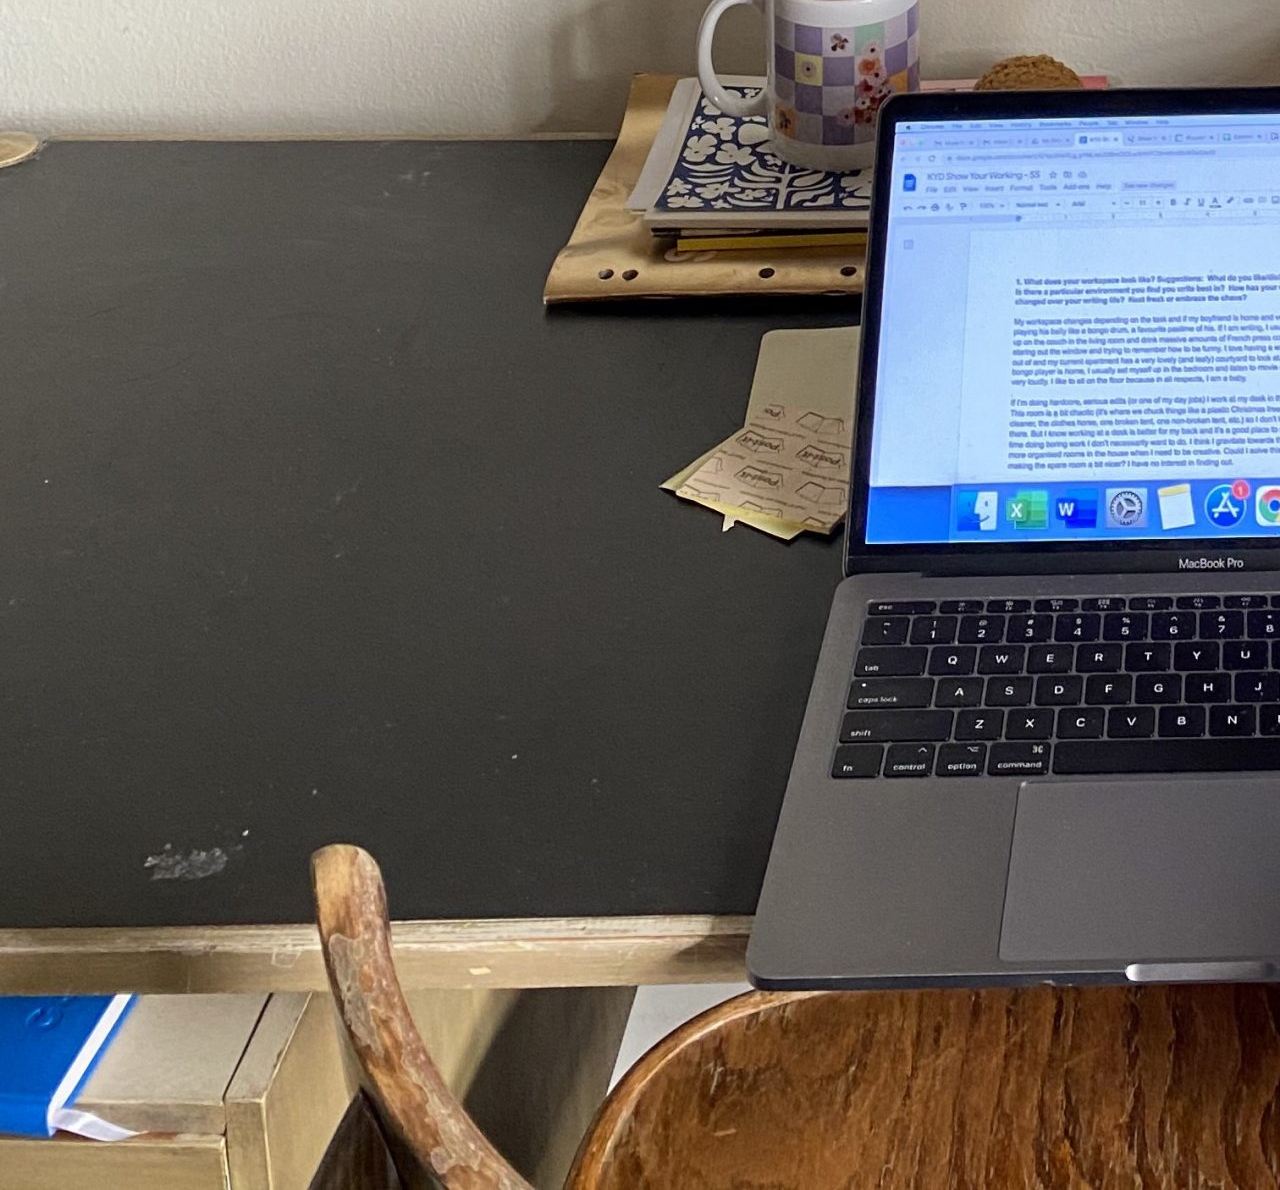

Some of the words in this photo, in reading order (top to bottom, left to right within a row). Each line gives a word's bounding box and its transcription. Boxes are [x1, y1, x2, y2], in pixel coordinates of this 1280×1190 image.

[946, 171, 969, 180] Show
[970, 170, 988, 180] Your
[989, 170, 1023, 181] Working
[1010, 503, 1023, 518] X
[1058, 502, 1074, 516] W
[1178, 557, 1222, 570] MacBook
[1224, 557, 1244, 569] Pro
[850, 729, 871, 737] shift
[947, 763, 977, 771] option
[997, 761, 1042, 769] command
